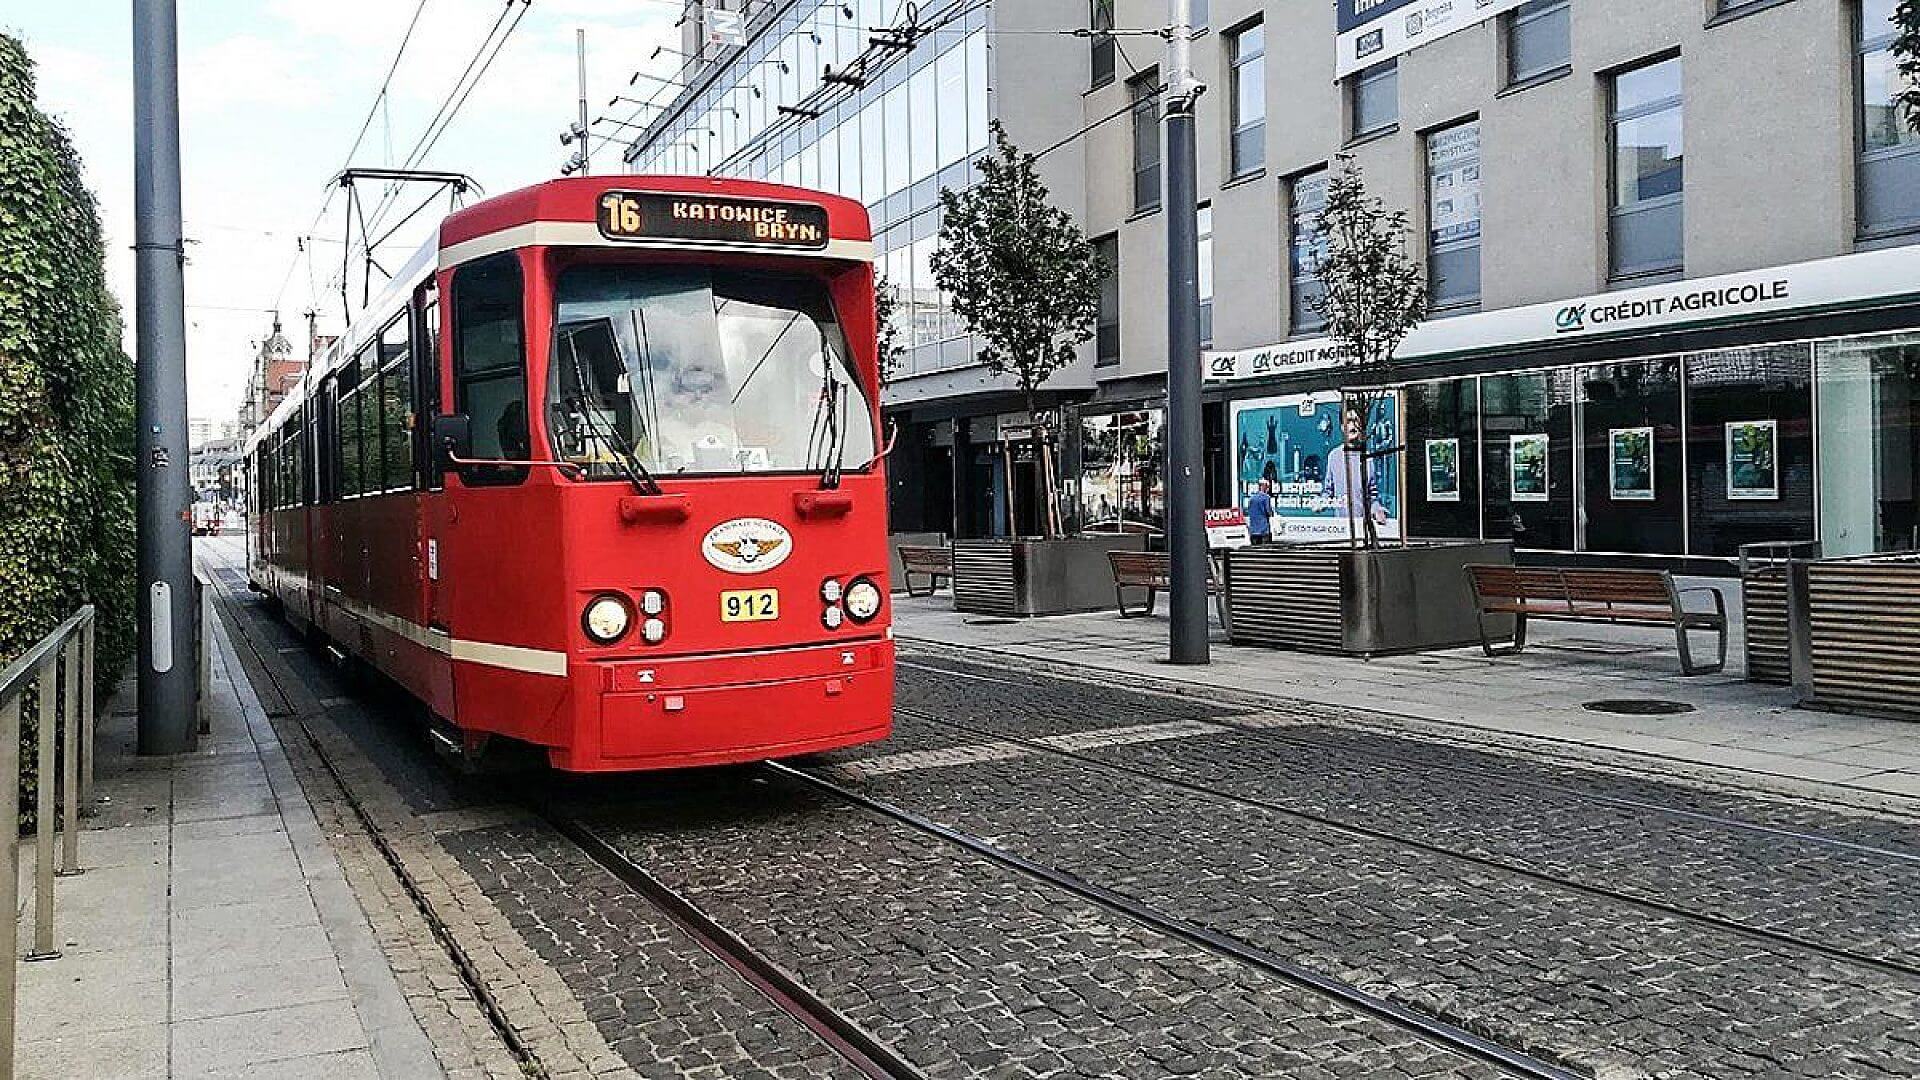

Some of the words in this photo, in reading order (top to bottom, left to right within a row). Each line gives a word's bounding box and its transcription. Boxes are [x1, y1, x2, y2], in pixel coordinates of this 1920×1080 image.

[602, 195, 640, 233] 16
[673, 202, 787, 224] KATOWICE
[754, 222, 822, 241] BRYN.
[1590, 299, 1665, 323] CRÉDIT
[1669, 280, 1789, 313] AGRICOLE
[1273, 348, 1318, 366] CRÉDIT
[727, 595, 774, 616] 912
